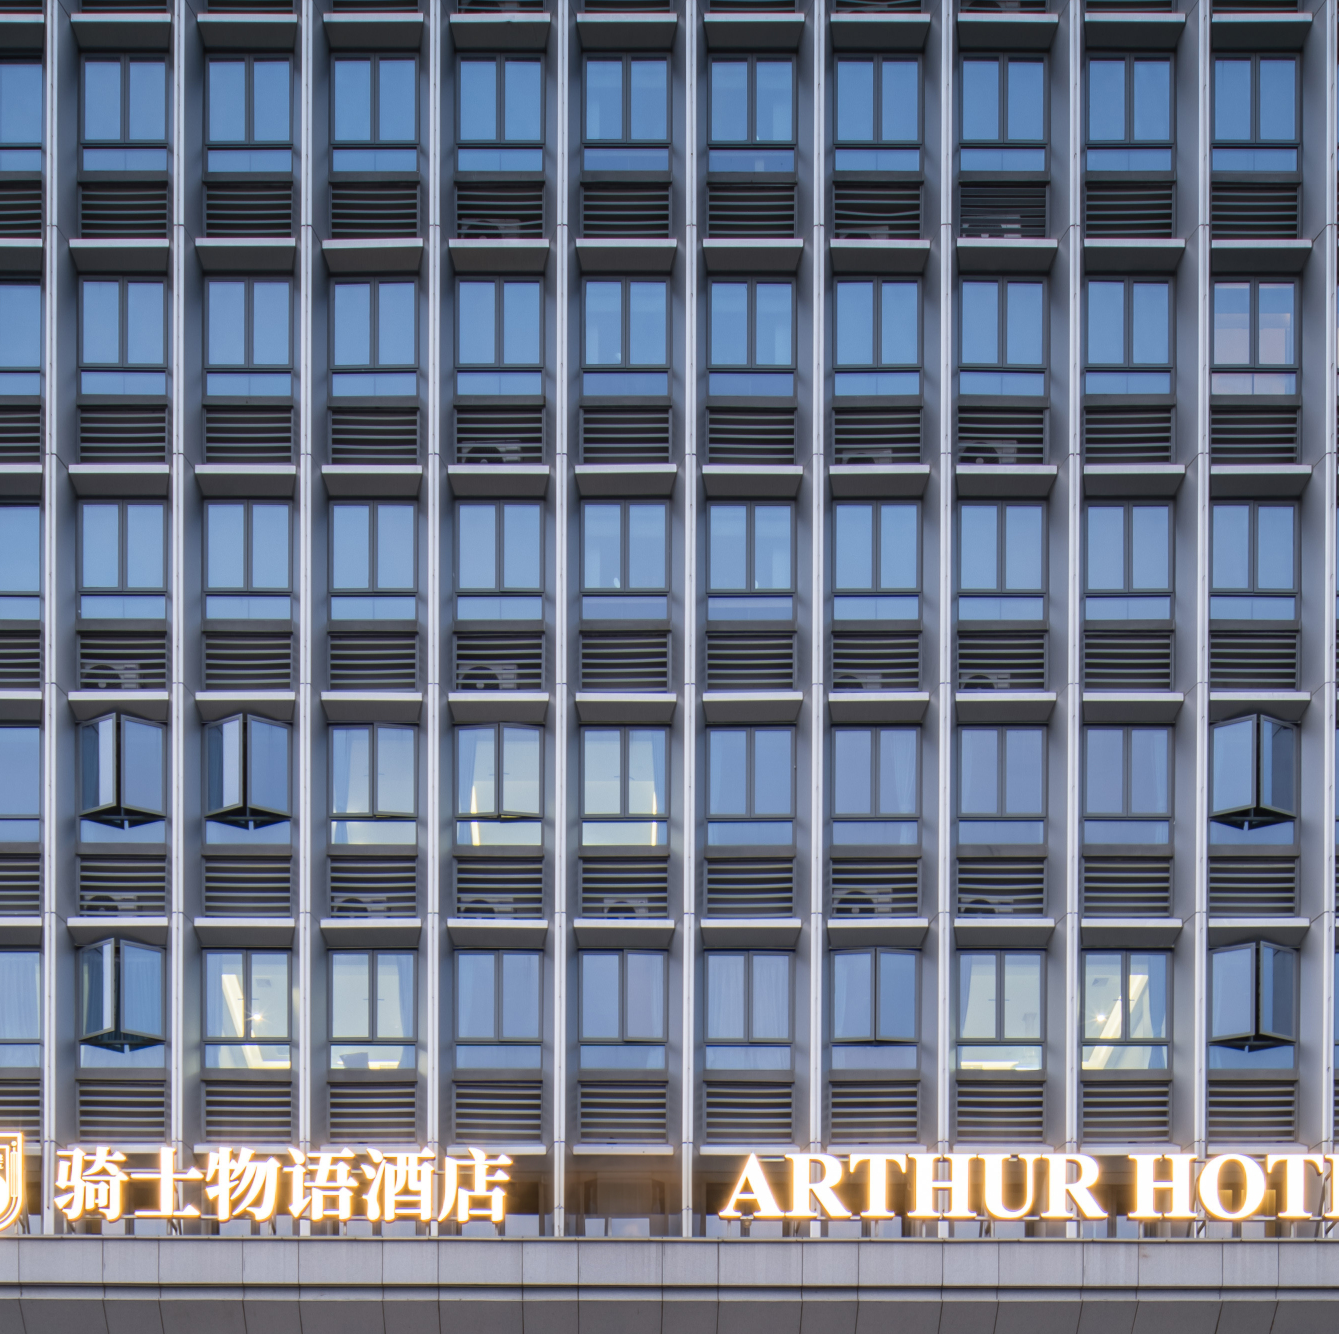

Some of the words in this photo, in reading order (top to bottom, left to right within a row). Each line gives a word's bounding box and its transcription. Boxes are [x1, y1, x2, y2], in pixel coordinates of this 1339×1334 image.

[53, 1146, 513, 1223] 骑士物语酒店
[718, 1153, 1108, 1221] ARTHUR
